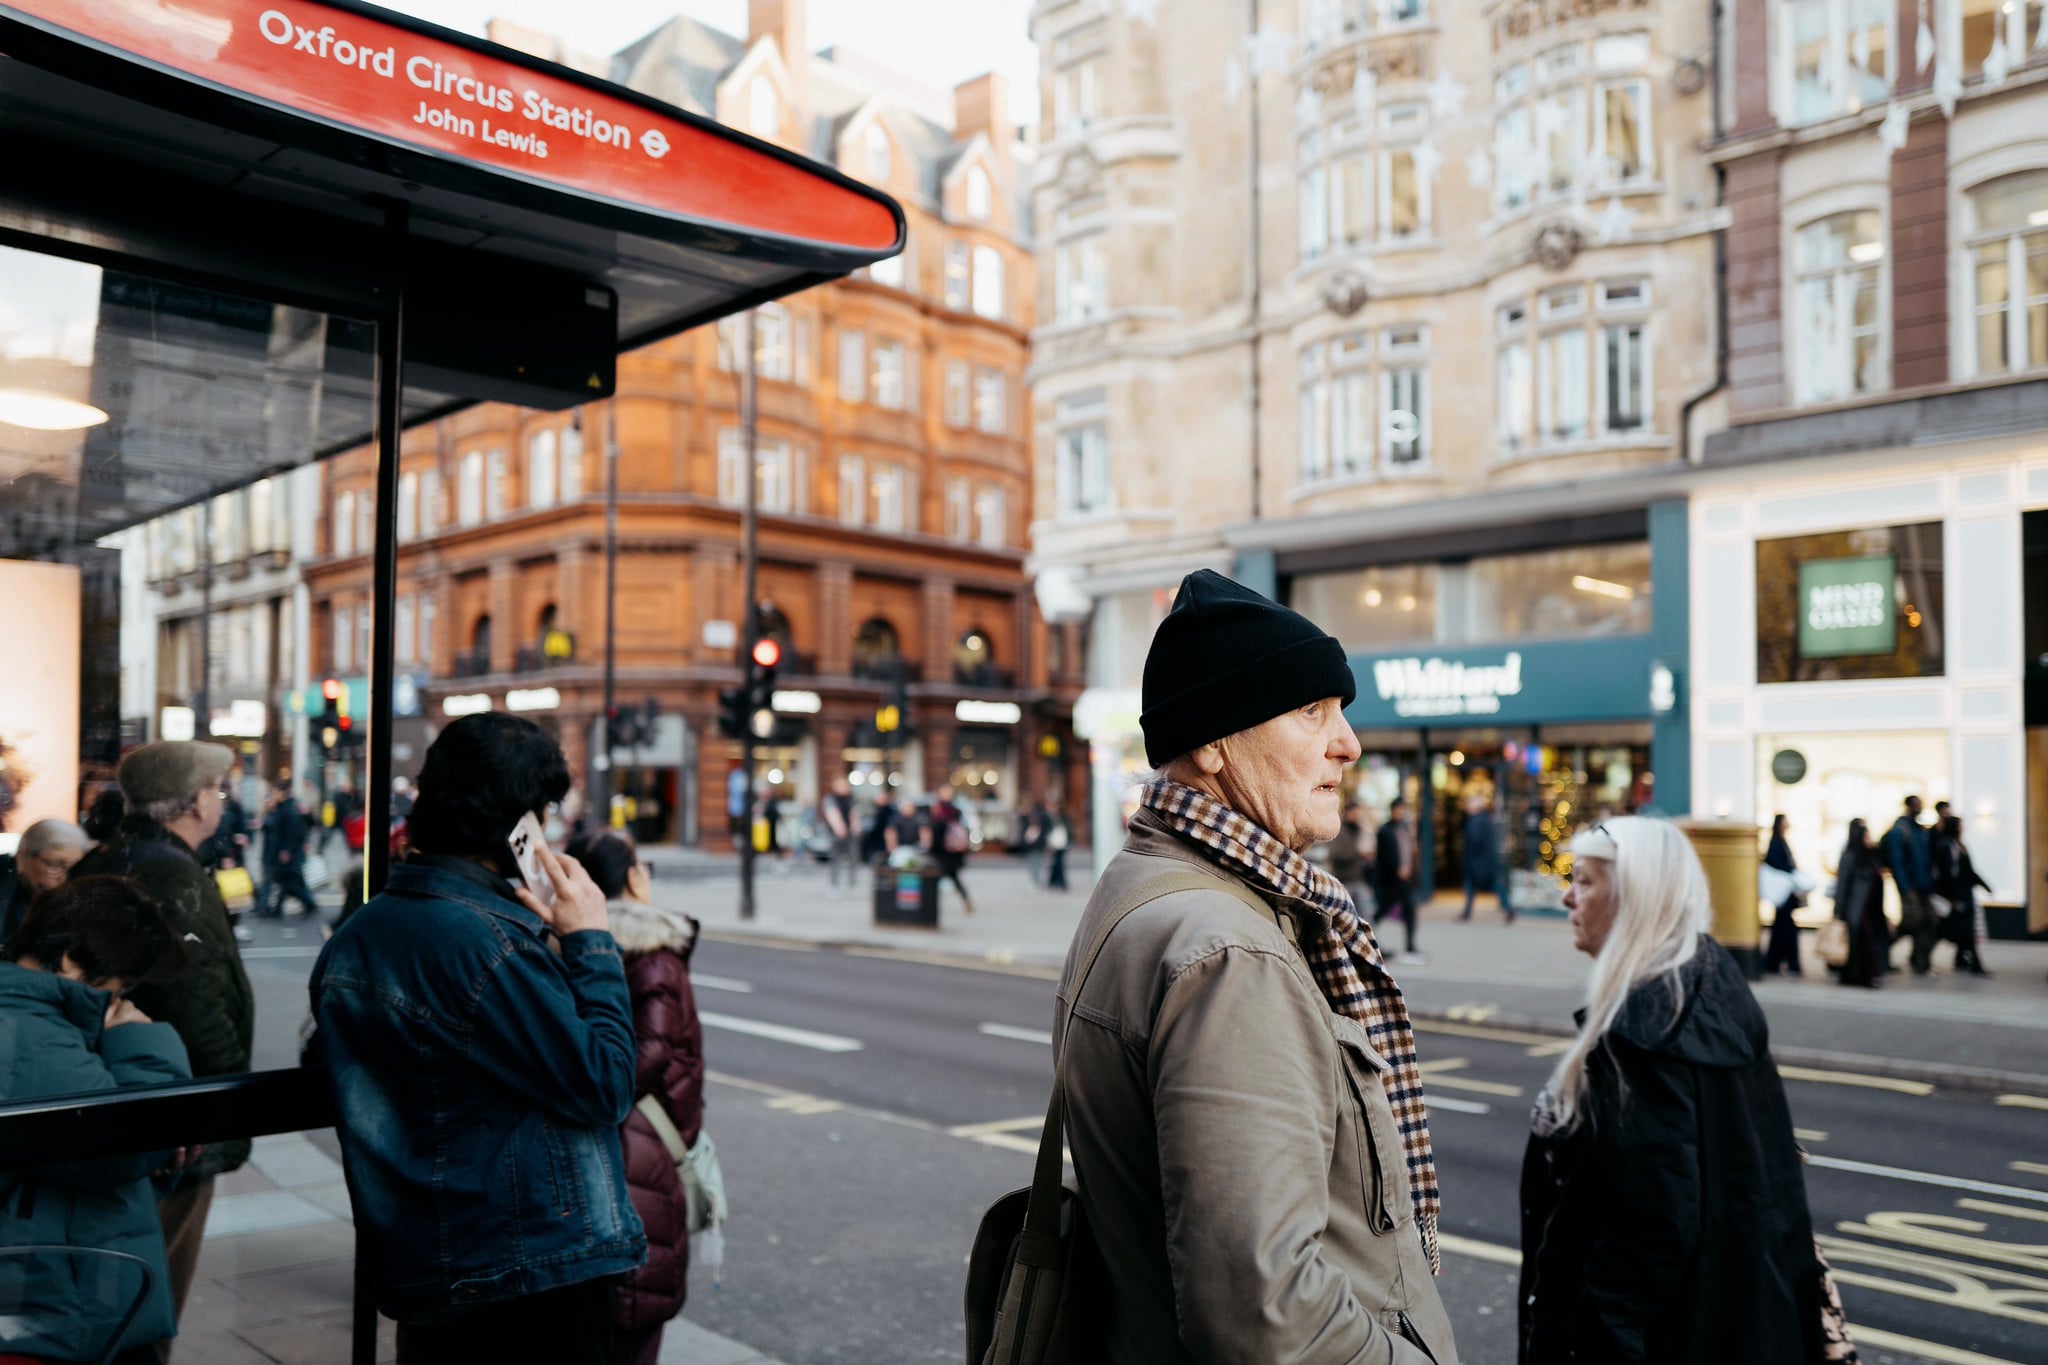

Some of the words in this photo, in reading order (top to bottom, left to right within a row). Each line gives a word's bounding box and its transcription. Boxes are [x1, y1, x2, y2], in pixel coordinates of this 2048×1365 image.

[259, 10, 395, 78] Oxford
[406, 56, 513, 114] Circus
[524, 89, 631, 150] Station
[413, 102, 474, 138] John
[482, 115, 549, 158] Lewis
